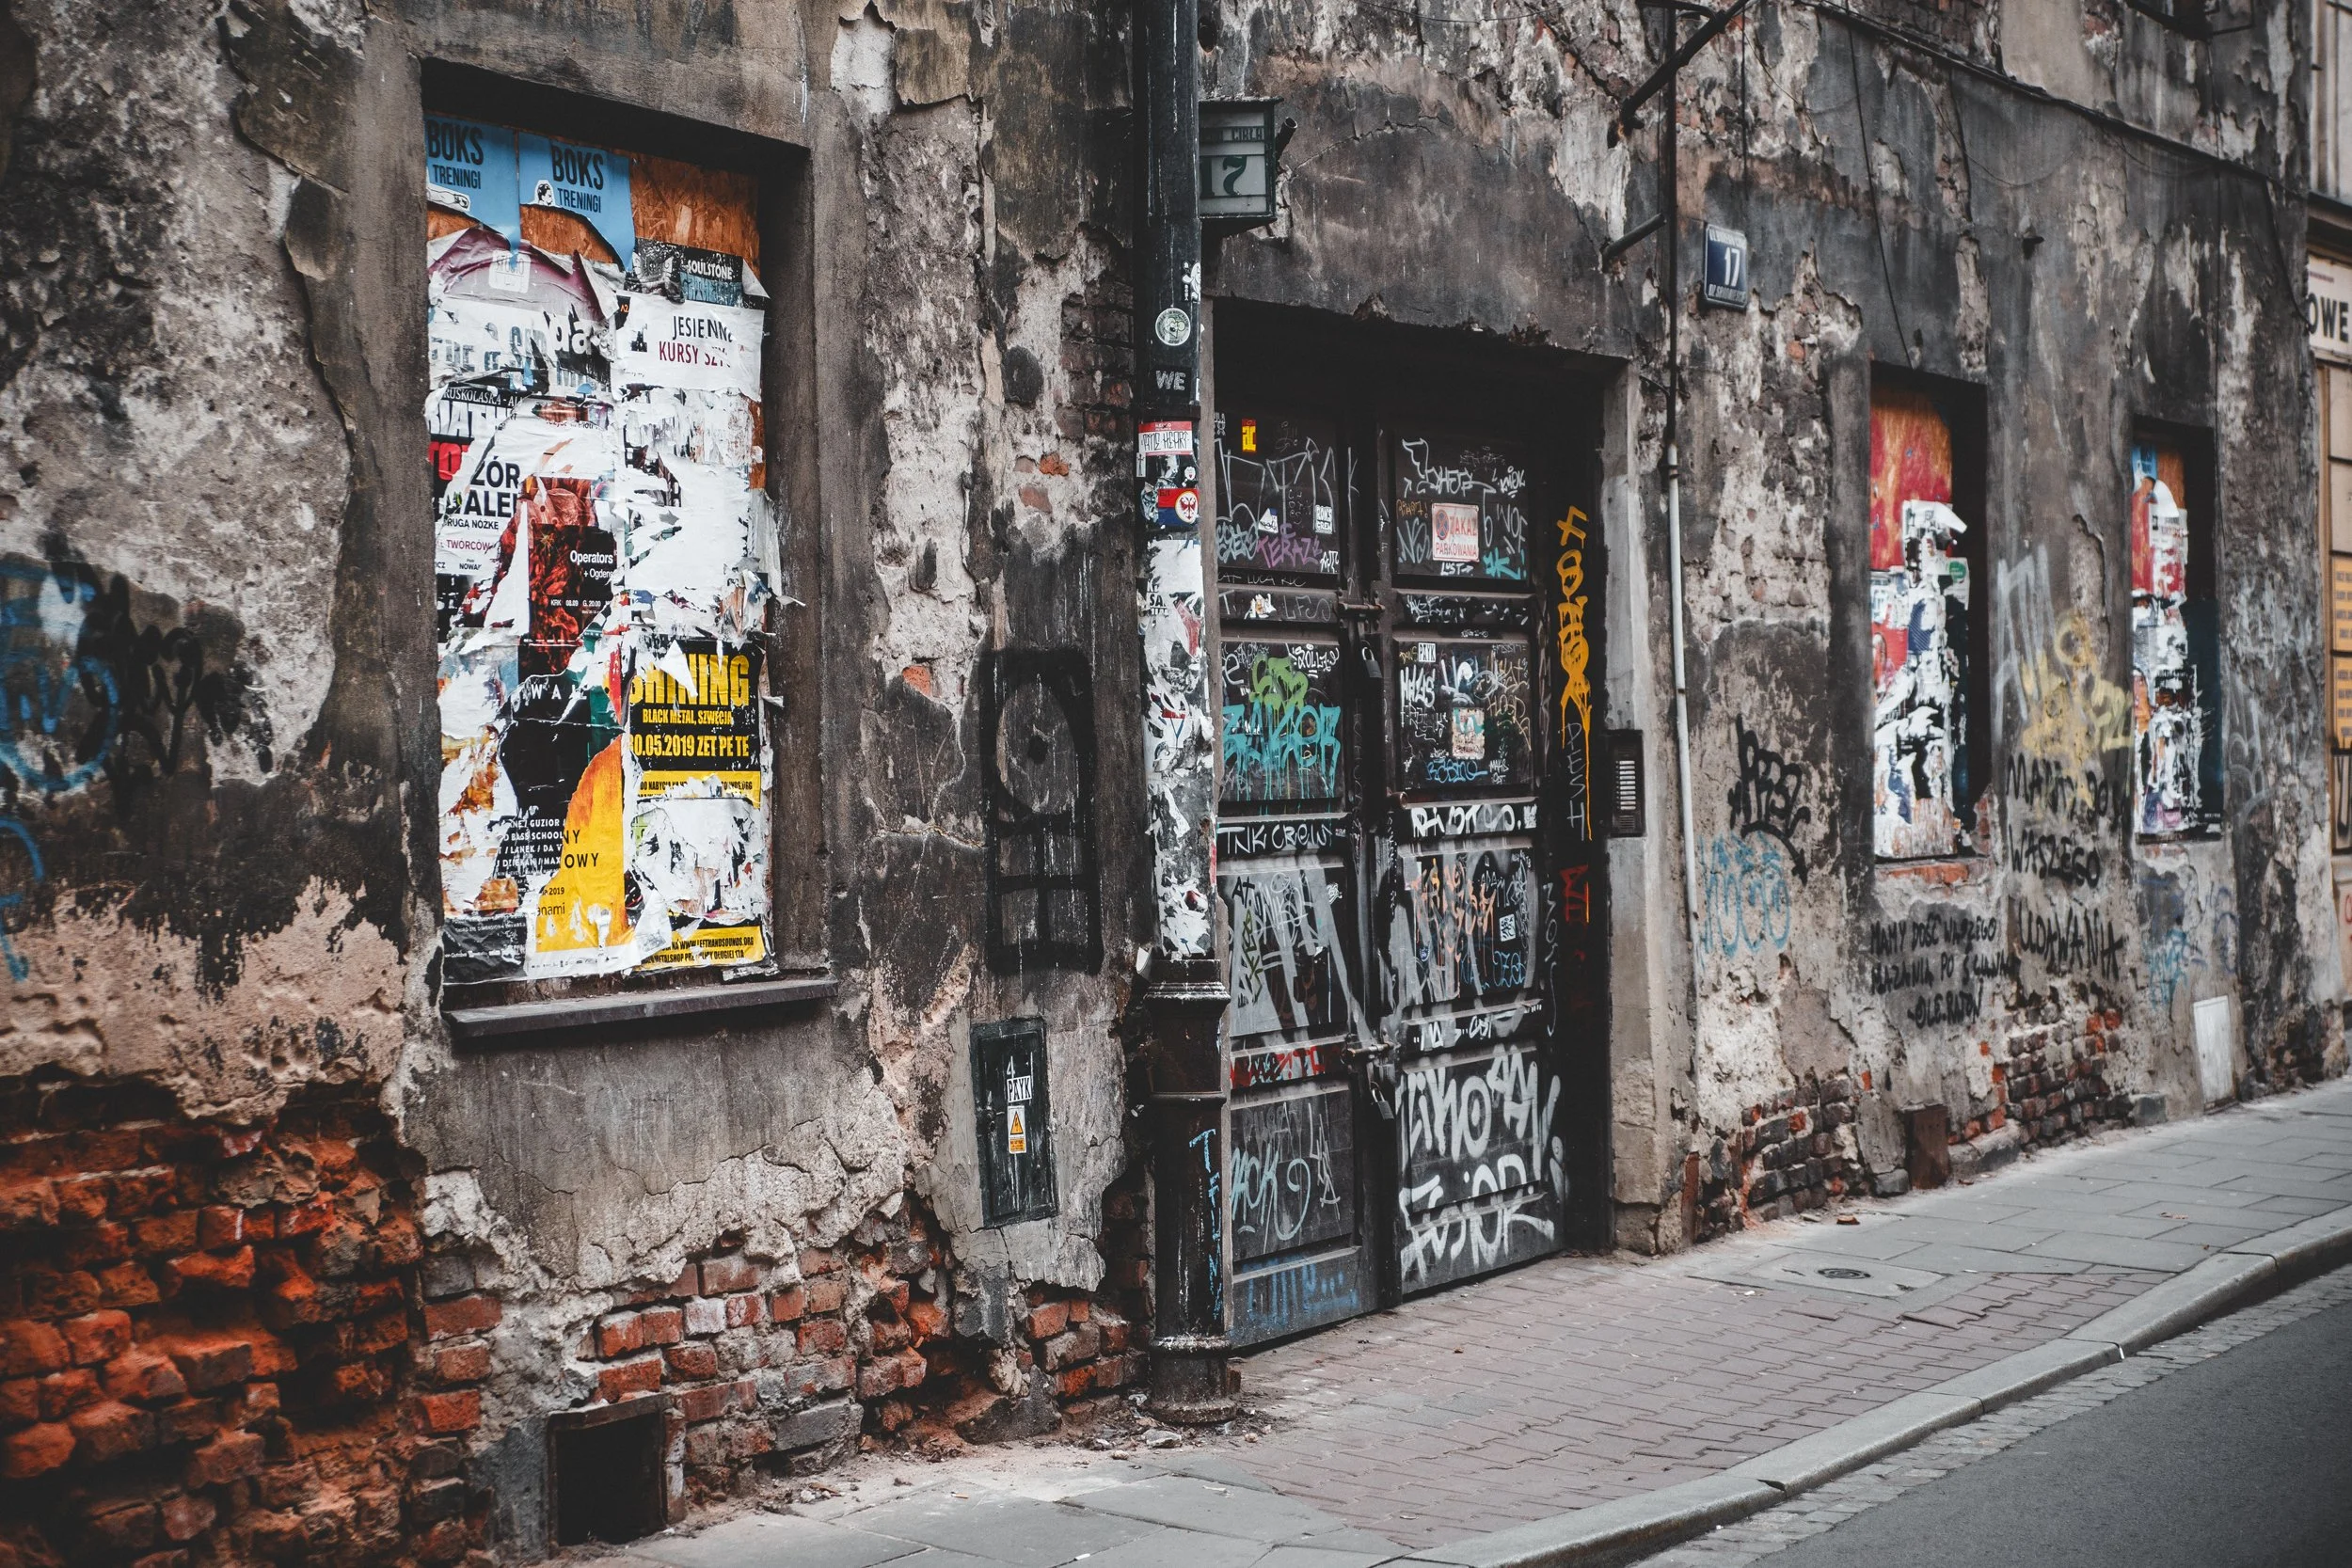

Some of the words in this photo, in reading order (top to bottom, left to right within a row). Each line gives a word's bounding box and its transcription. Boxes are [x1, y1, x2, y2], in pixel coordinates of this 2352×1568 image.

[426, 119, 485, 166] BOKS
[433, 164, 482, 189] TRENINGI
[551, 145, 604, 190] BOKS
[557, 187, 602, 214] TRENINGI
[687, 260, 734, 280] SOULSTONE
[1724, 246, 1740, 287] 17
[659, 341, 699, 365] KURSY
[1155, 370, 1186, 390] WE
[569, 550, 614, 566] Operators
[1419, 643, 1436, 662] PAYK
[643, 708, 669, 723] BLACK
[670, 709, 697, 725] METAL,
[697, 710, 732, 725] SZWECJA
[696, 735, 717, 756] ZET
[719, 736, 734, 756] PE
[737, 736, 750, 756] TE
[640, 782, 648, 790] DO
[530, 818, 560, 828] GUZIOR
[532, 832, 564, 841] SCHOOL
[549, 887, 565, 895] 2019
[680, 937, 755, 950] WWWEFTHANDSOUNDS.ORG
[1941, 951, 1955, 981] PO
[1009, 1077, 1031, 1101] PAYK
